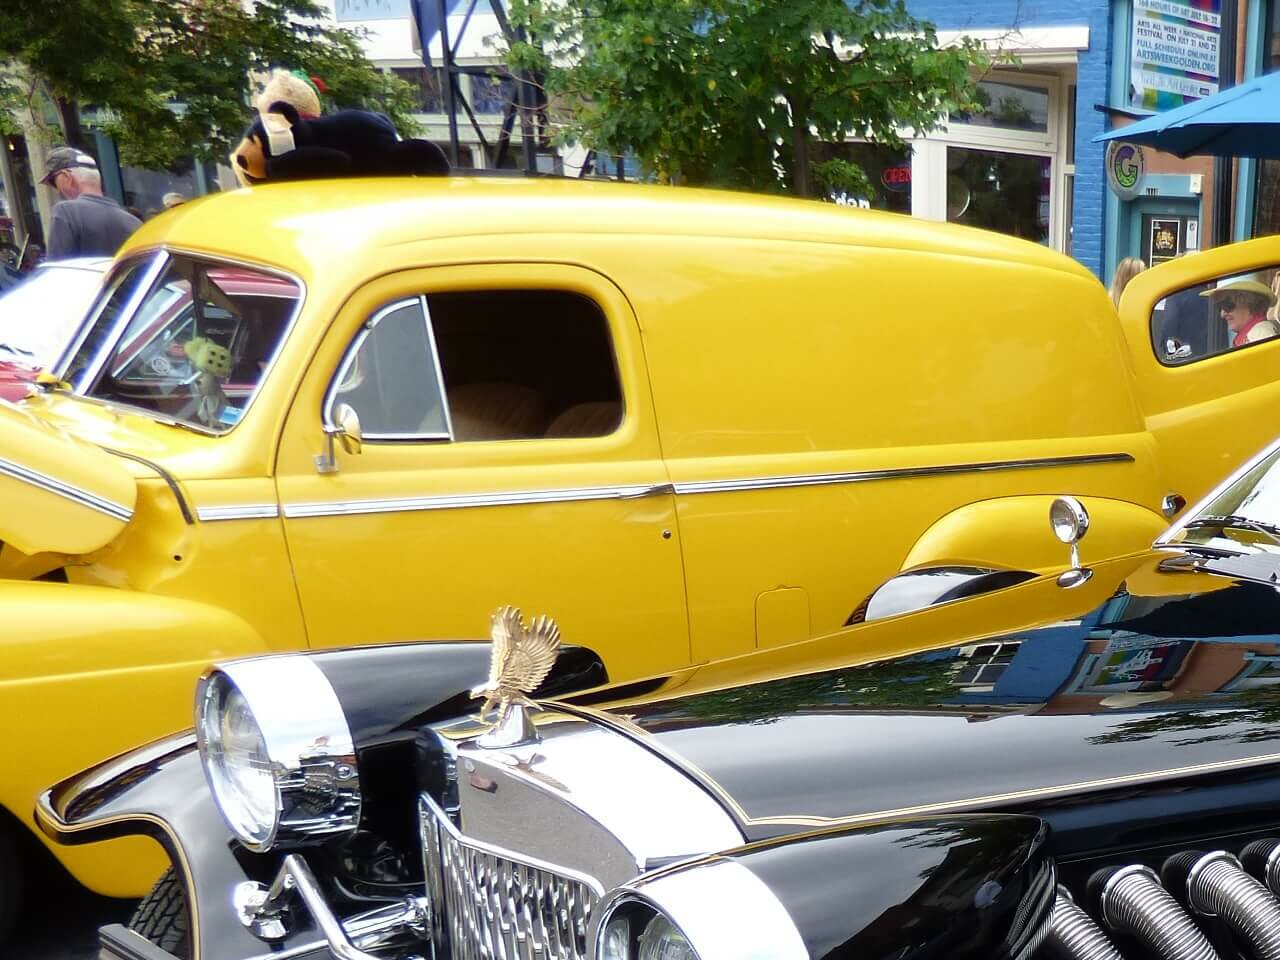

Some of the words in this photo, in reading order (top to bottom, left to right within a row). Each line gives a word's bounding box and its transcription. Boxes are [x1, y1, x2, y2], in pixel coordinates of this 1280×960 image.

[1150, 0, 1171, 13] HOURS
[1172, 5, 1180, 14] OF
[1181, 6, 1189, 16] ART
[1190, 8, 1202, 19] JULY
[1137, 20, 1150, 29] ARTS
[1164, 25, 1177, 33] WEEK
[1183, 29, 1204, 41] NATIONAL
[1206, 35, 1217, 43] ARTS
[1137, 28, 1163, 39] FESTIVAL
[1166, 34, 1177, 42] ON
[1178, 37, 1190, 46] JULY
[1198, 41, 1210, 50] AND
[1136, 39, 1152, 50] FULL
[1154, 42, 1186, 55] SCHEDULE
[1187, 49, 1209, 60] ONLINE
[1136, 48, 1217, 73] ARTSWEEKGOLDEN.ORG
[882, 167, 913, 184] OPEN
